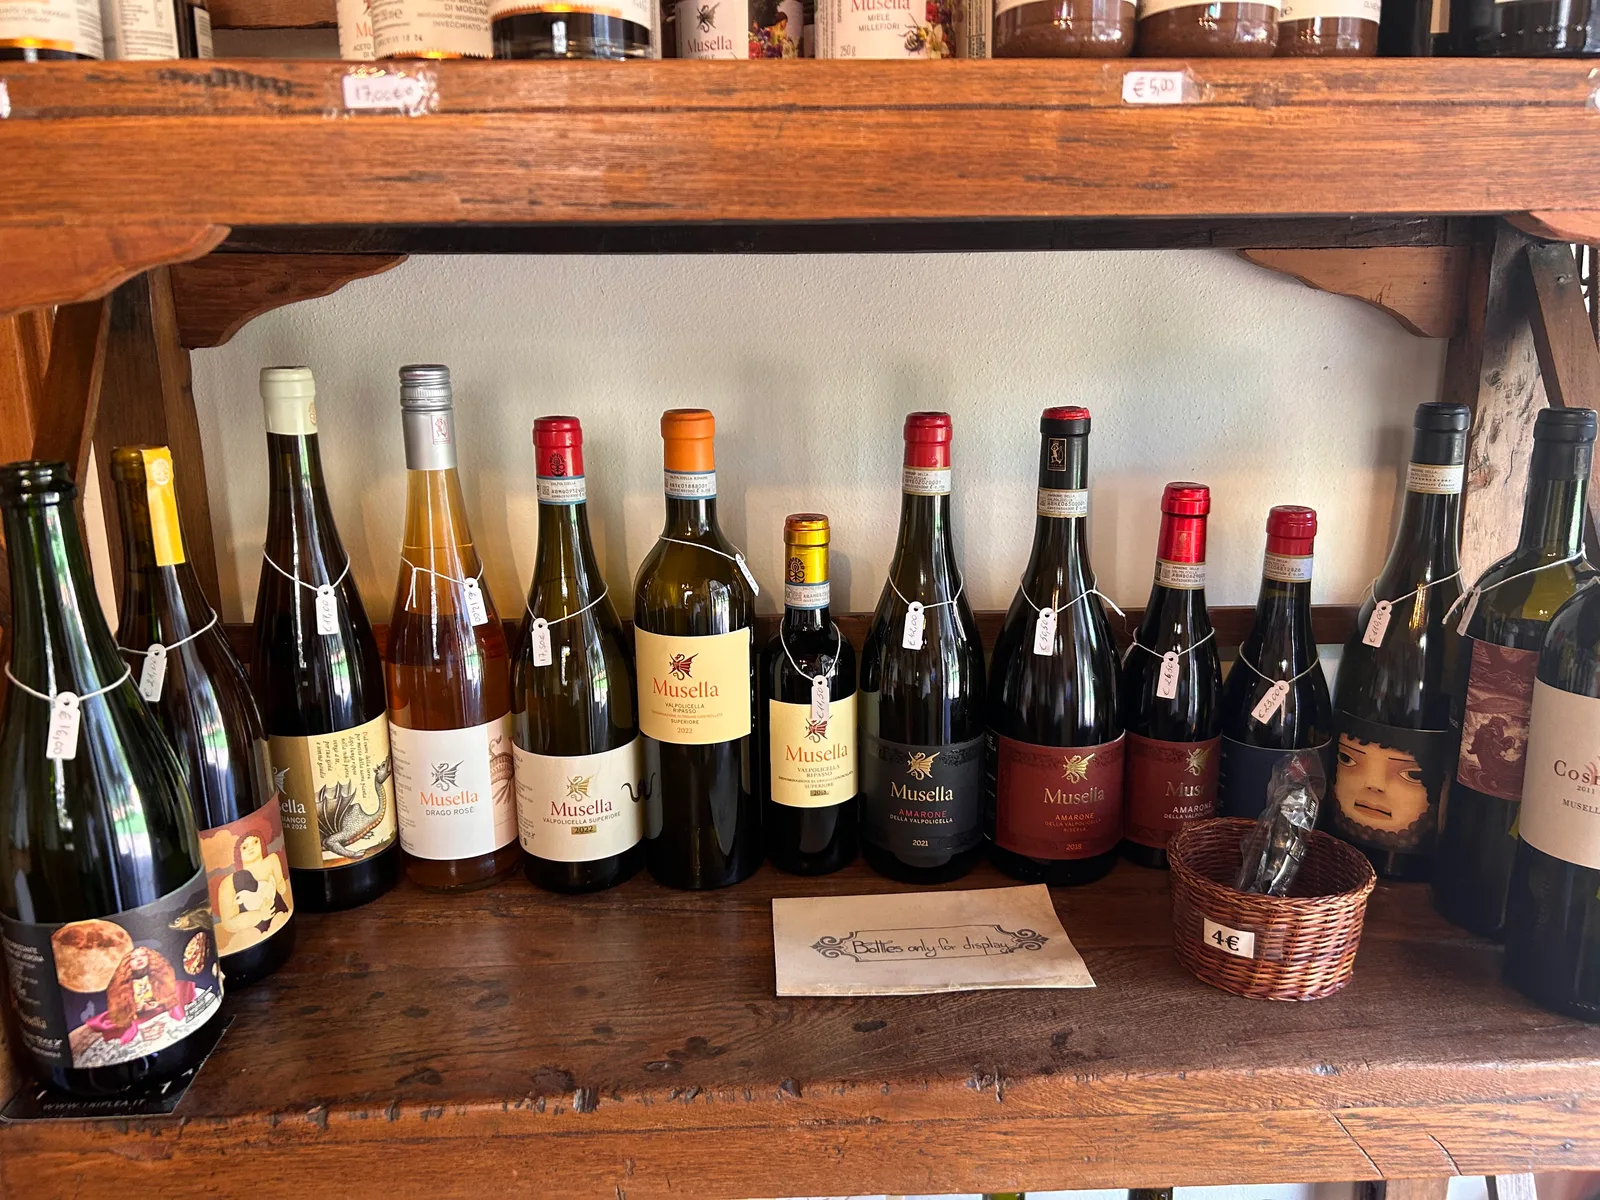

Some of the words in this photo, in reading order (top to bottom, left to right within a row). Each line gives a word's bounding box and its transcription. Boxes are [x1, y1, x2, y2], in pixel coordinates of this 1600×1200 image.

[867, 13, 891, 22] MIELE
[858, 23, 900, 32] MILLEFIORI
[687, 35, 732, 54] Musella
[652, 676, 719, 699] Musella
[785, 743, 848, 763] Musella
[797, 764, 840, 773] VALPOLICELLA
[890, 781, 954, 802] Musella
[1043, 786, 1105, 805] Musella
[1577, 785, 1595, 795] 2011
[419, 790, 479, 807] Musella
[453, 806, 475, 815] ROSÉ
[550, 798, 613, 817] Musella
[1172, 801, 1213, 813] AMARONE
[1563, 797, 1600, 815] MUSELL
[542, 817, 588, 825] VALPOLICELLA
[588, 810, 621, 824] SUPERIORE
[889, 813, 908, 822] DELLA
[909, 817, 953, 825] VALPOLICELLA
[899, 808, 947, 819] AMARONE
[1055, 812, 1095, 821] AMARONE
[574, 825, 594, 834] 2022
[912, 839, 929, 847] 2021
[907, 938, 937, 958] only
[963, 935, 1010, 956] display
[1211, 929, 1240, 952] 4€
